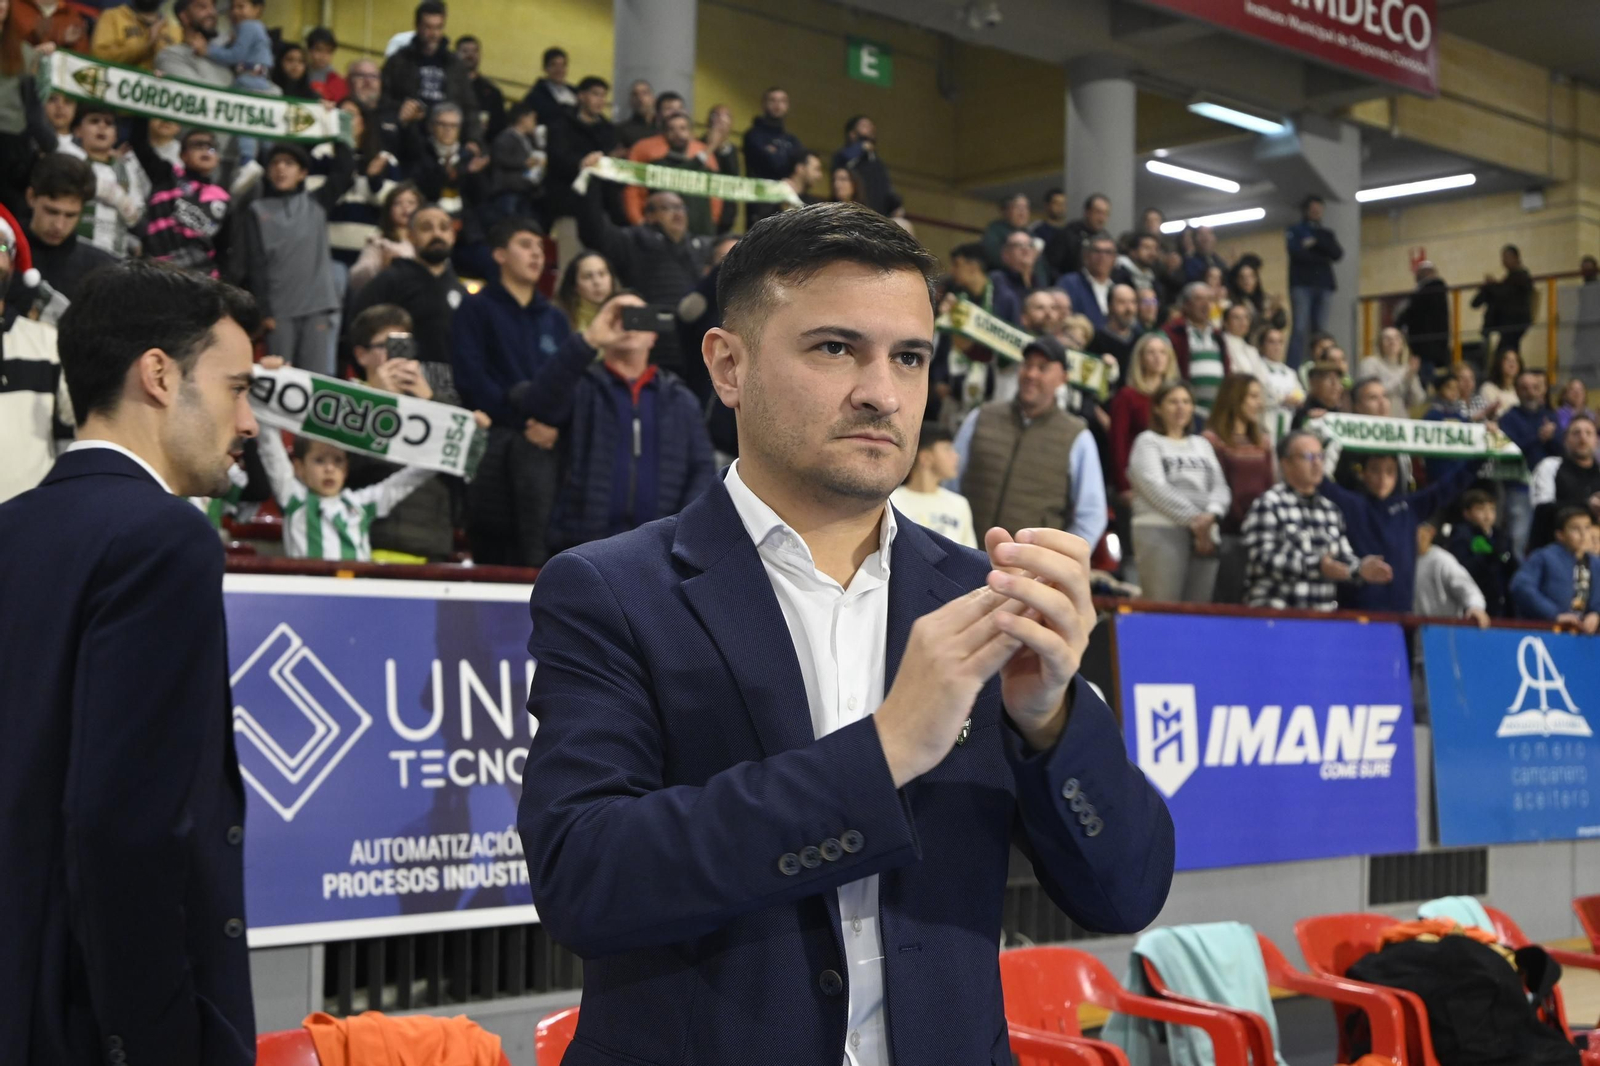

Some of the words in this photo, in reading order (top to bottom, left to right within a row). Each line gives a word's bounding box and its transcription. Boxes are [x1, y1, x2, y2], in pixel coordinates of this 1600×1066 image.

[1290, 0, 1431, 50] DECO
[860, 45, 880, 77] E
[117, 75, 208, 116] CÓRDOBA
[215, 102, 277, 128] FUTSAL
[440, 412, 470, 468] 1954
[1414, 426, 1475, 445] FUTSAL
[1204, 704, 1402, 767] IMANE
[323, 866, 440, 899] PROCESOS
